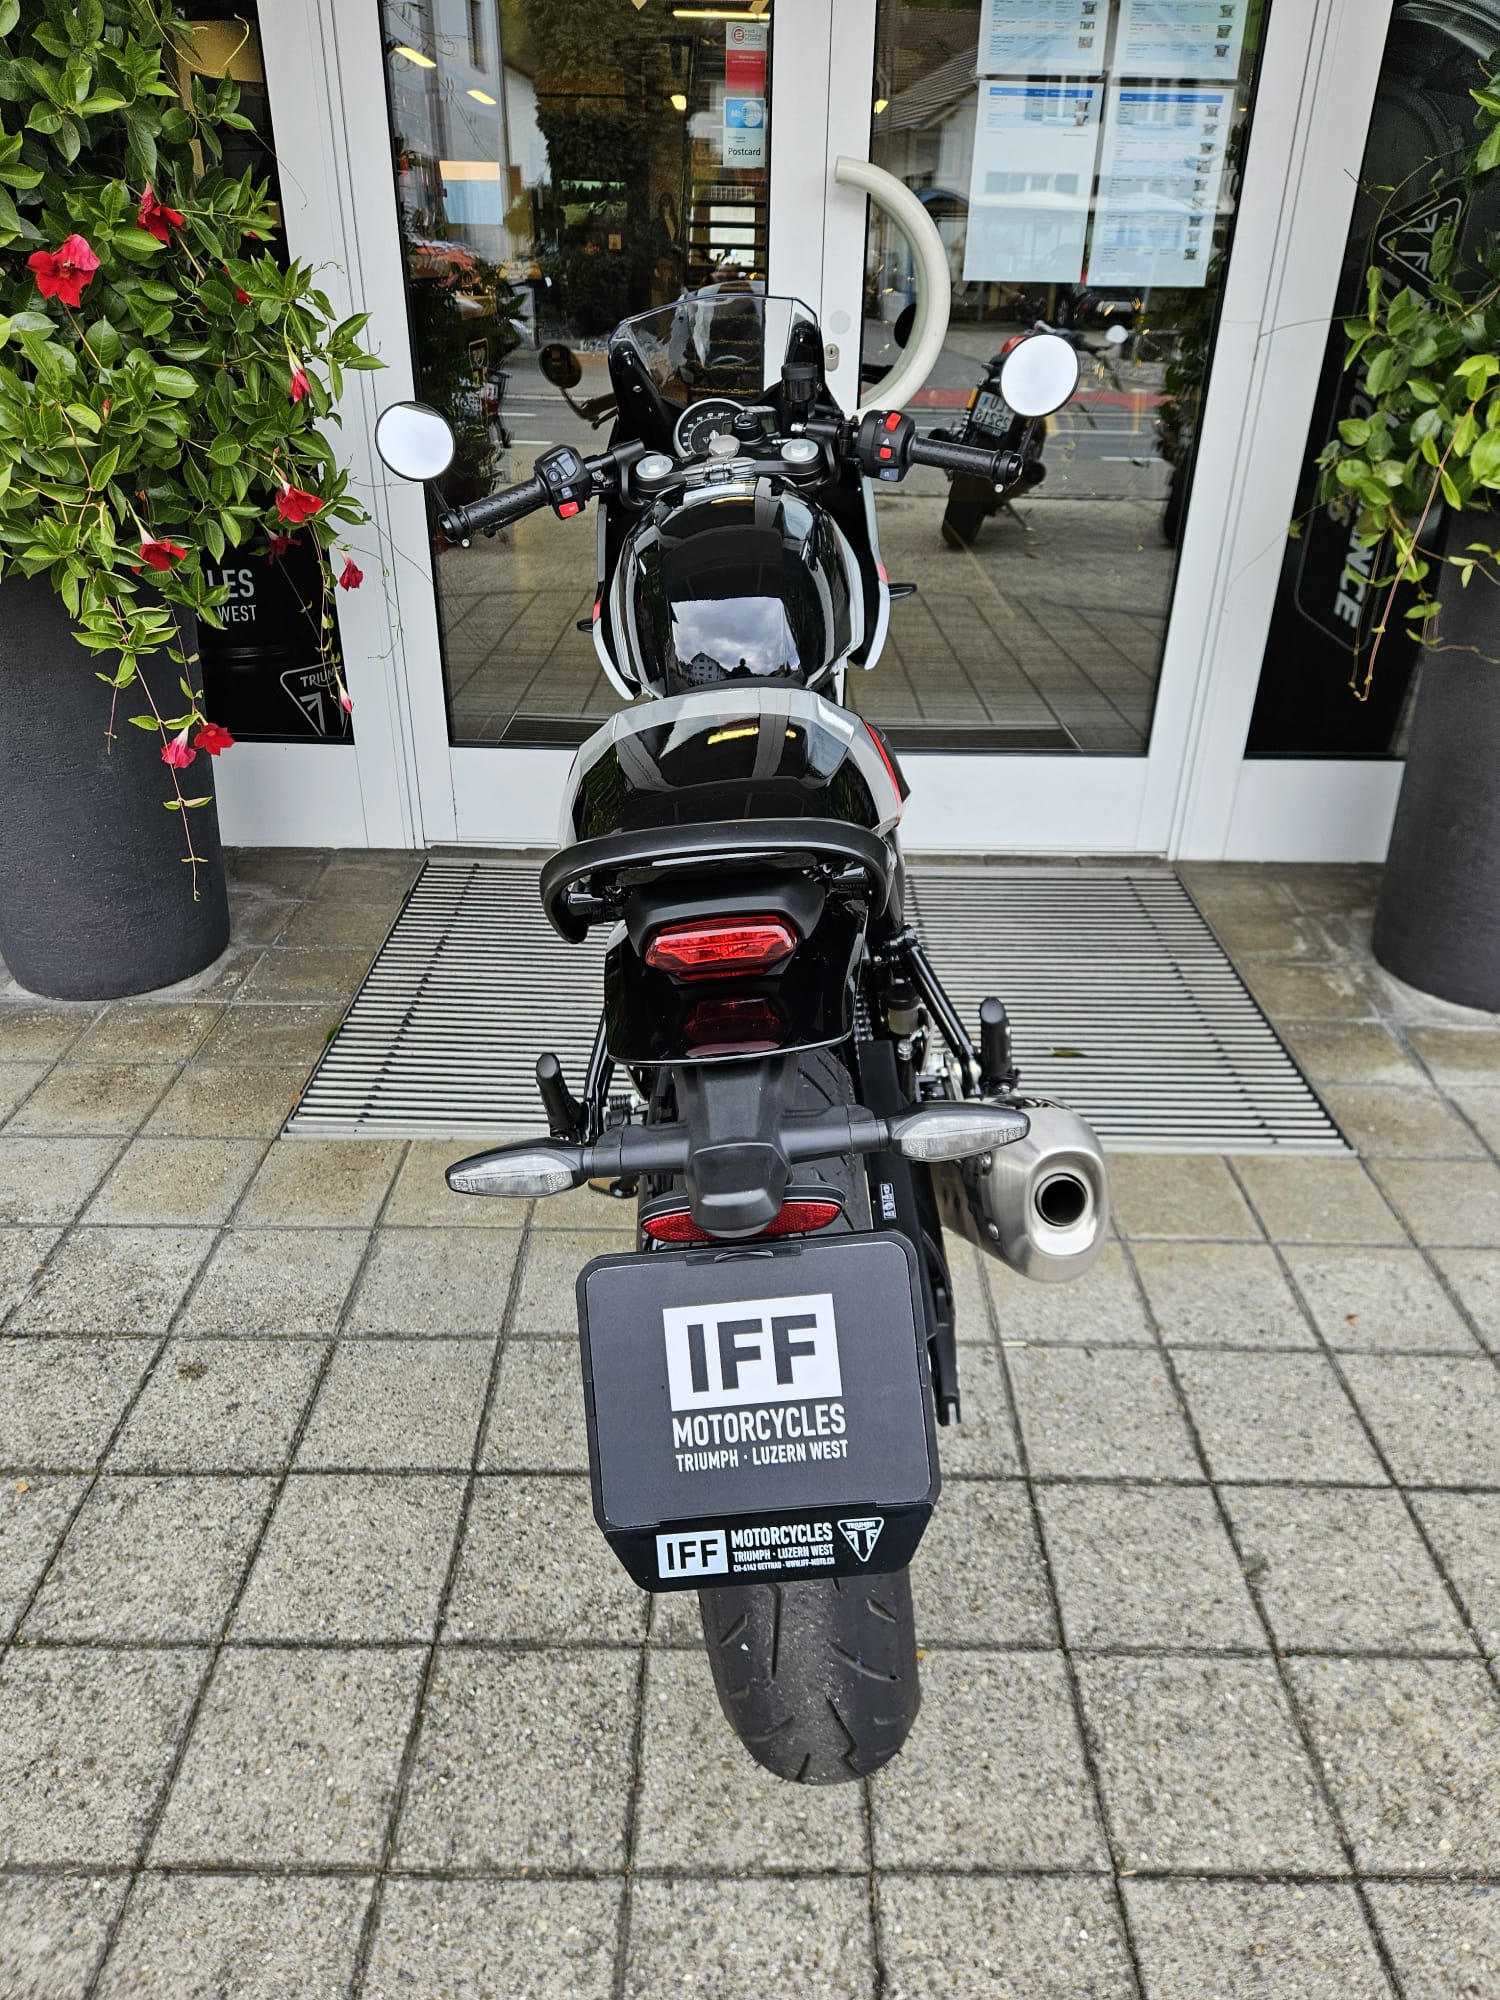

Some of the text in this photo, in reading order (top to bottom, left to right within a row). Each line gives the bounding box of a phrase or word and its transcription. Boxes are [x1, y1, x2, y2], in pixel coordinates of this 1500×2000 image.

[728, 147, 761, 156] Postcard
[207, 568, 255, 598] LES
[217, 604, 257, 622] WEST
[687, 1313, 817, 1393] IFF
[672, 1403, 846, 1448] MOTORCYCLES
[676, 1440, 848, 1472] TRIUMPH LUZERN WEST
[731, 1522, 833, 1548] MOTORCYCLES
[665, 1539, 718, 1571] IFF
[733, 1544, 834, 1561] TRIUMPH LUZERN WEST
